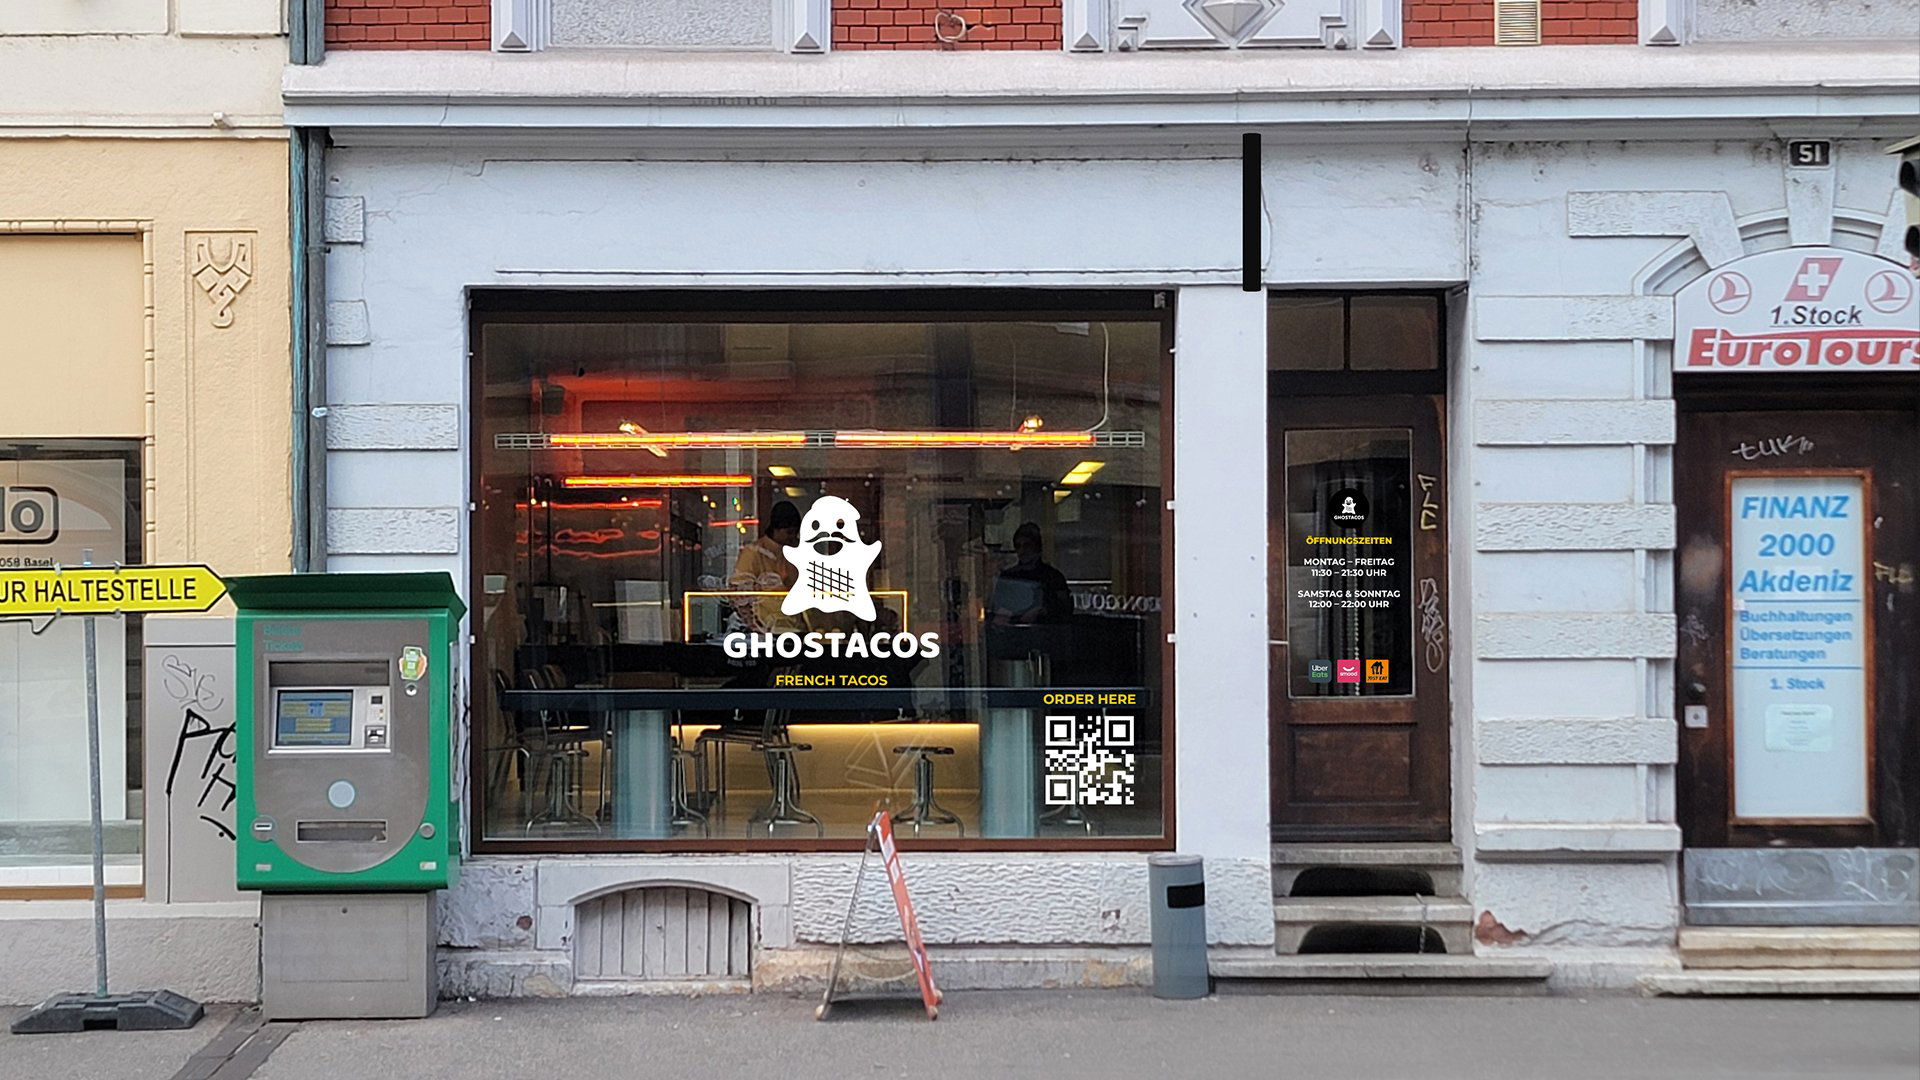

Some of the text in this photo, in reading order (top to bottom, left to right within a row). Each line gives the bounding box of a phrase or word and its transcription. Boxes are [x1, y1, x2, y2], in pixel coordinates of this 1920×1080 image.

[1799, 143, 1821, 163] 51
[1770, 305, 1863, 325] 1.Stock
[1741, 495, 1850, 519] FINANZ
[1305, 535, 1393, 545] ÖFFNUNGSZEITEN
[1758, 533, 1835, 557] 2000
[24, 557, 54, 568] Basel
[1303, 558, 1346, 566] MONTAG
[1354, 558, 1395, 566] FREITAG
[1311, 569, 1333, 577] 11:30
[1340, 569, 1364, 577] 21:30
[1365, 569, 1387, 577] UHR
[1738, 569, 1854, 593] Akdeniz
[34, 577, 198, 603] HALTESTELLE
[1297, 590, 1401, 598] SAMSTAG & SONNTAG
[1308, 600, 1333, 608] 12:00
[1340, 600, 1366, 608] 22:00
[1368, 600, 1390, 608] UHR
[1739, 610, 1853, 625] Buchhaltungen
[1739, 627, 1853, 644] Übersetzungen
[723, 631, 940, 659] GHOSTACOS
[1739, 647, 1827, 662] Beratungen
[1311, 664, 1329, 672] Uber
[775, 675, 888, 687] FRENCH TACOS
[1786, 677, 1826, 690] Stock
[1043, 693, 1137, 705] ORDER HERE
